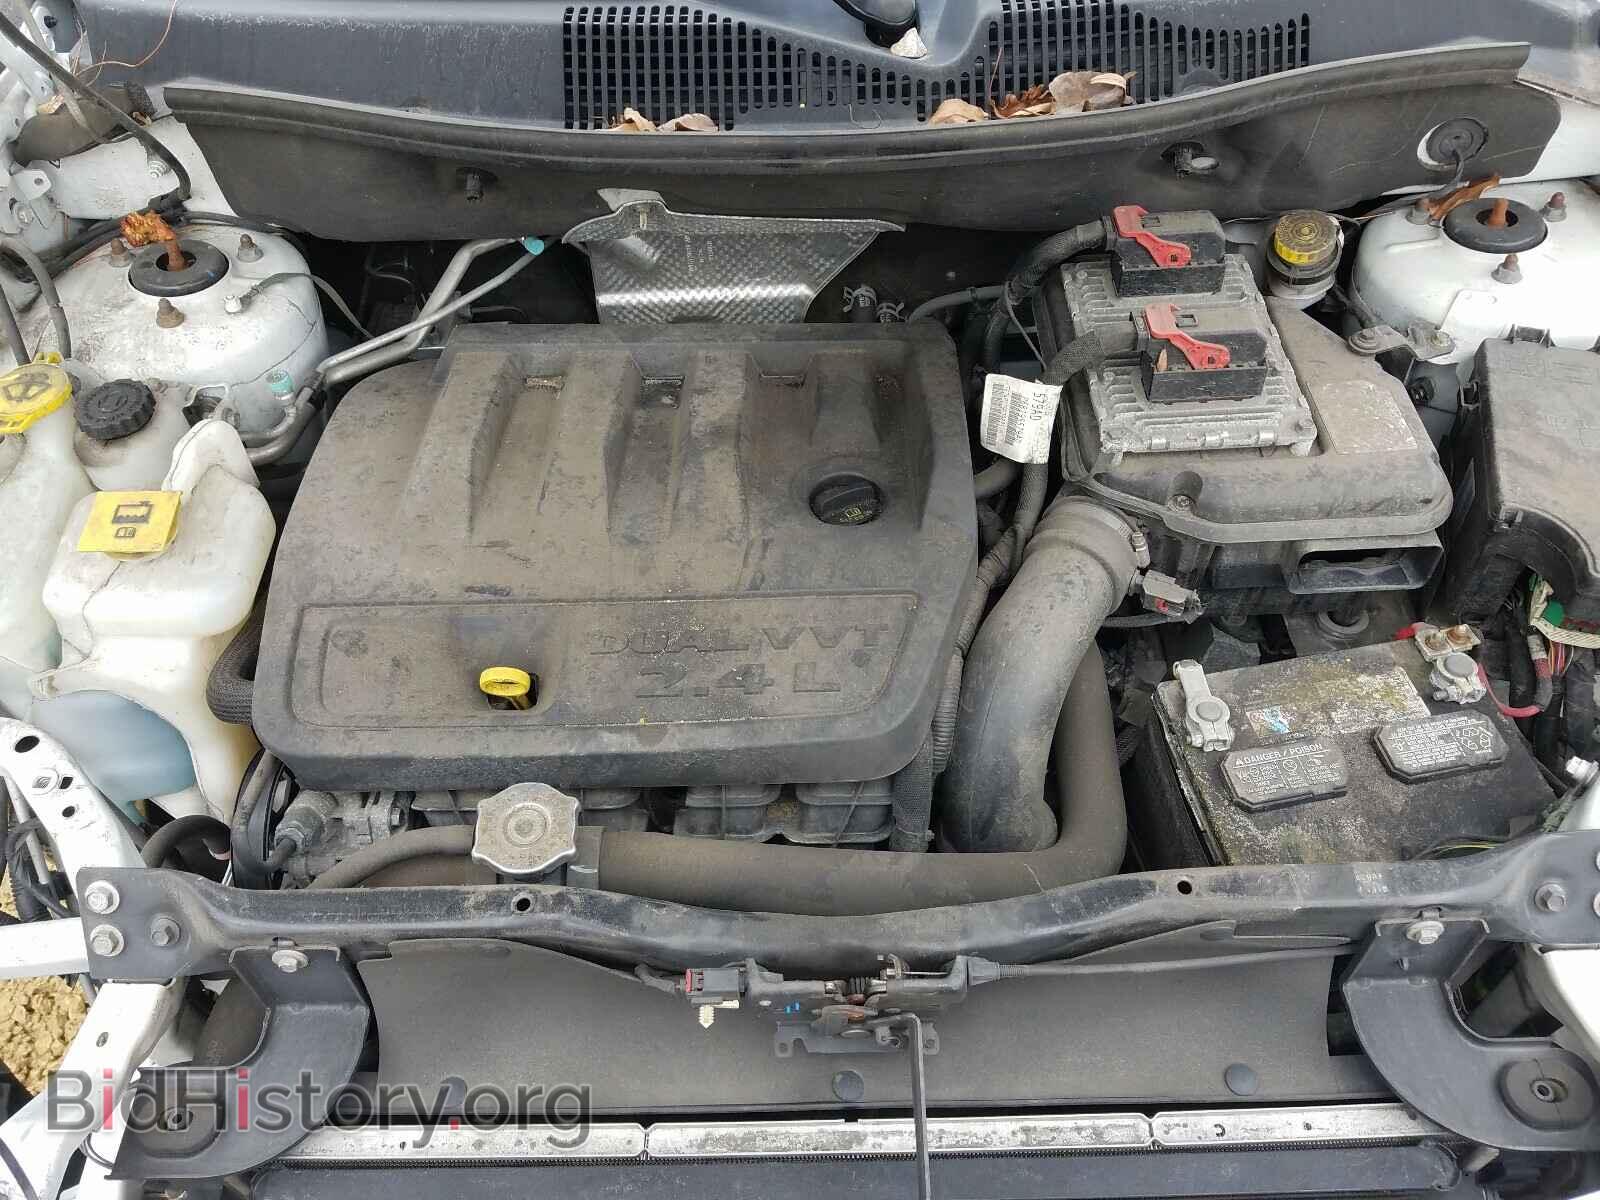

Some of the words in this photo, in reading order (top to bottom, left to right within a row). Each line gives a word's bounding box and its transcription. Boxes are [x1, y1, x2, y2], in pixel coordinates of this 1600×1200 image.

[590, 629, 749, 655] DUAL
[761, 624, 889, 650] VVT
[634, 661, 841, 698] 2.4L
[1244, 751, 1281, 764] DANGER
[1289, 743, 1323, 755] POISON
